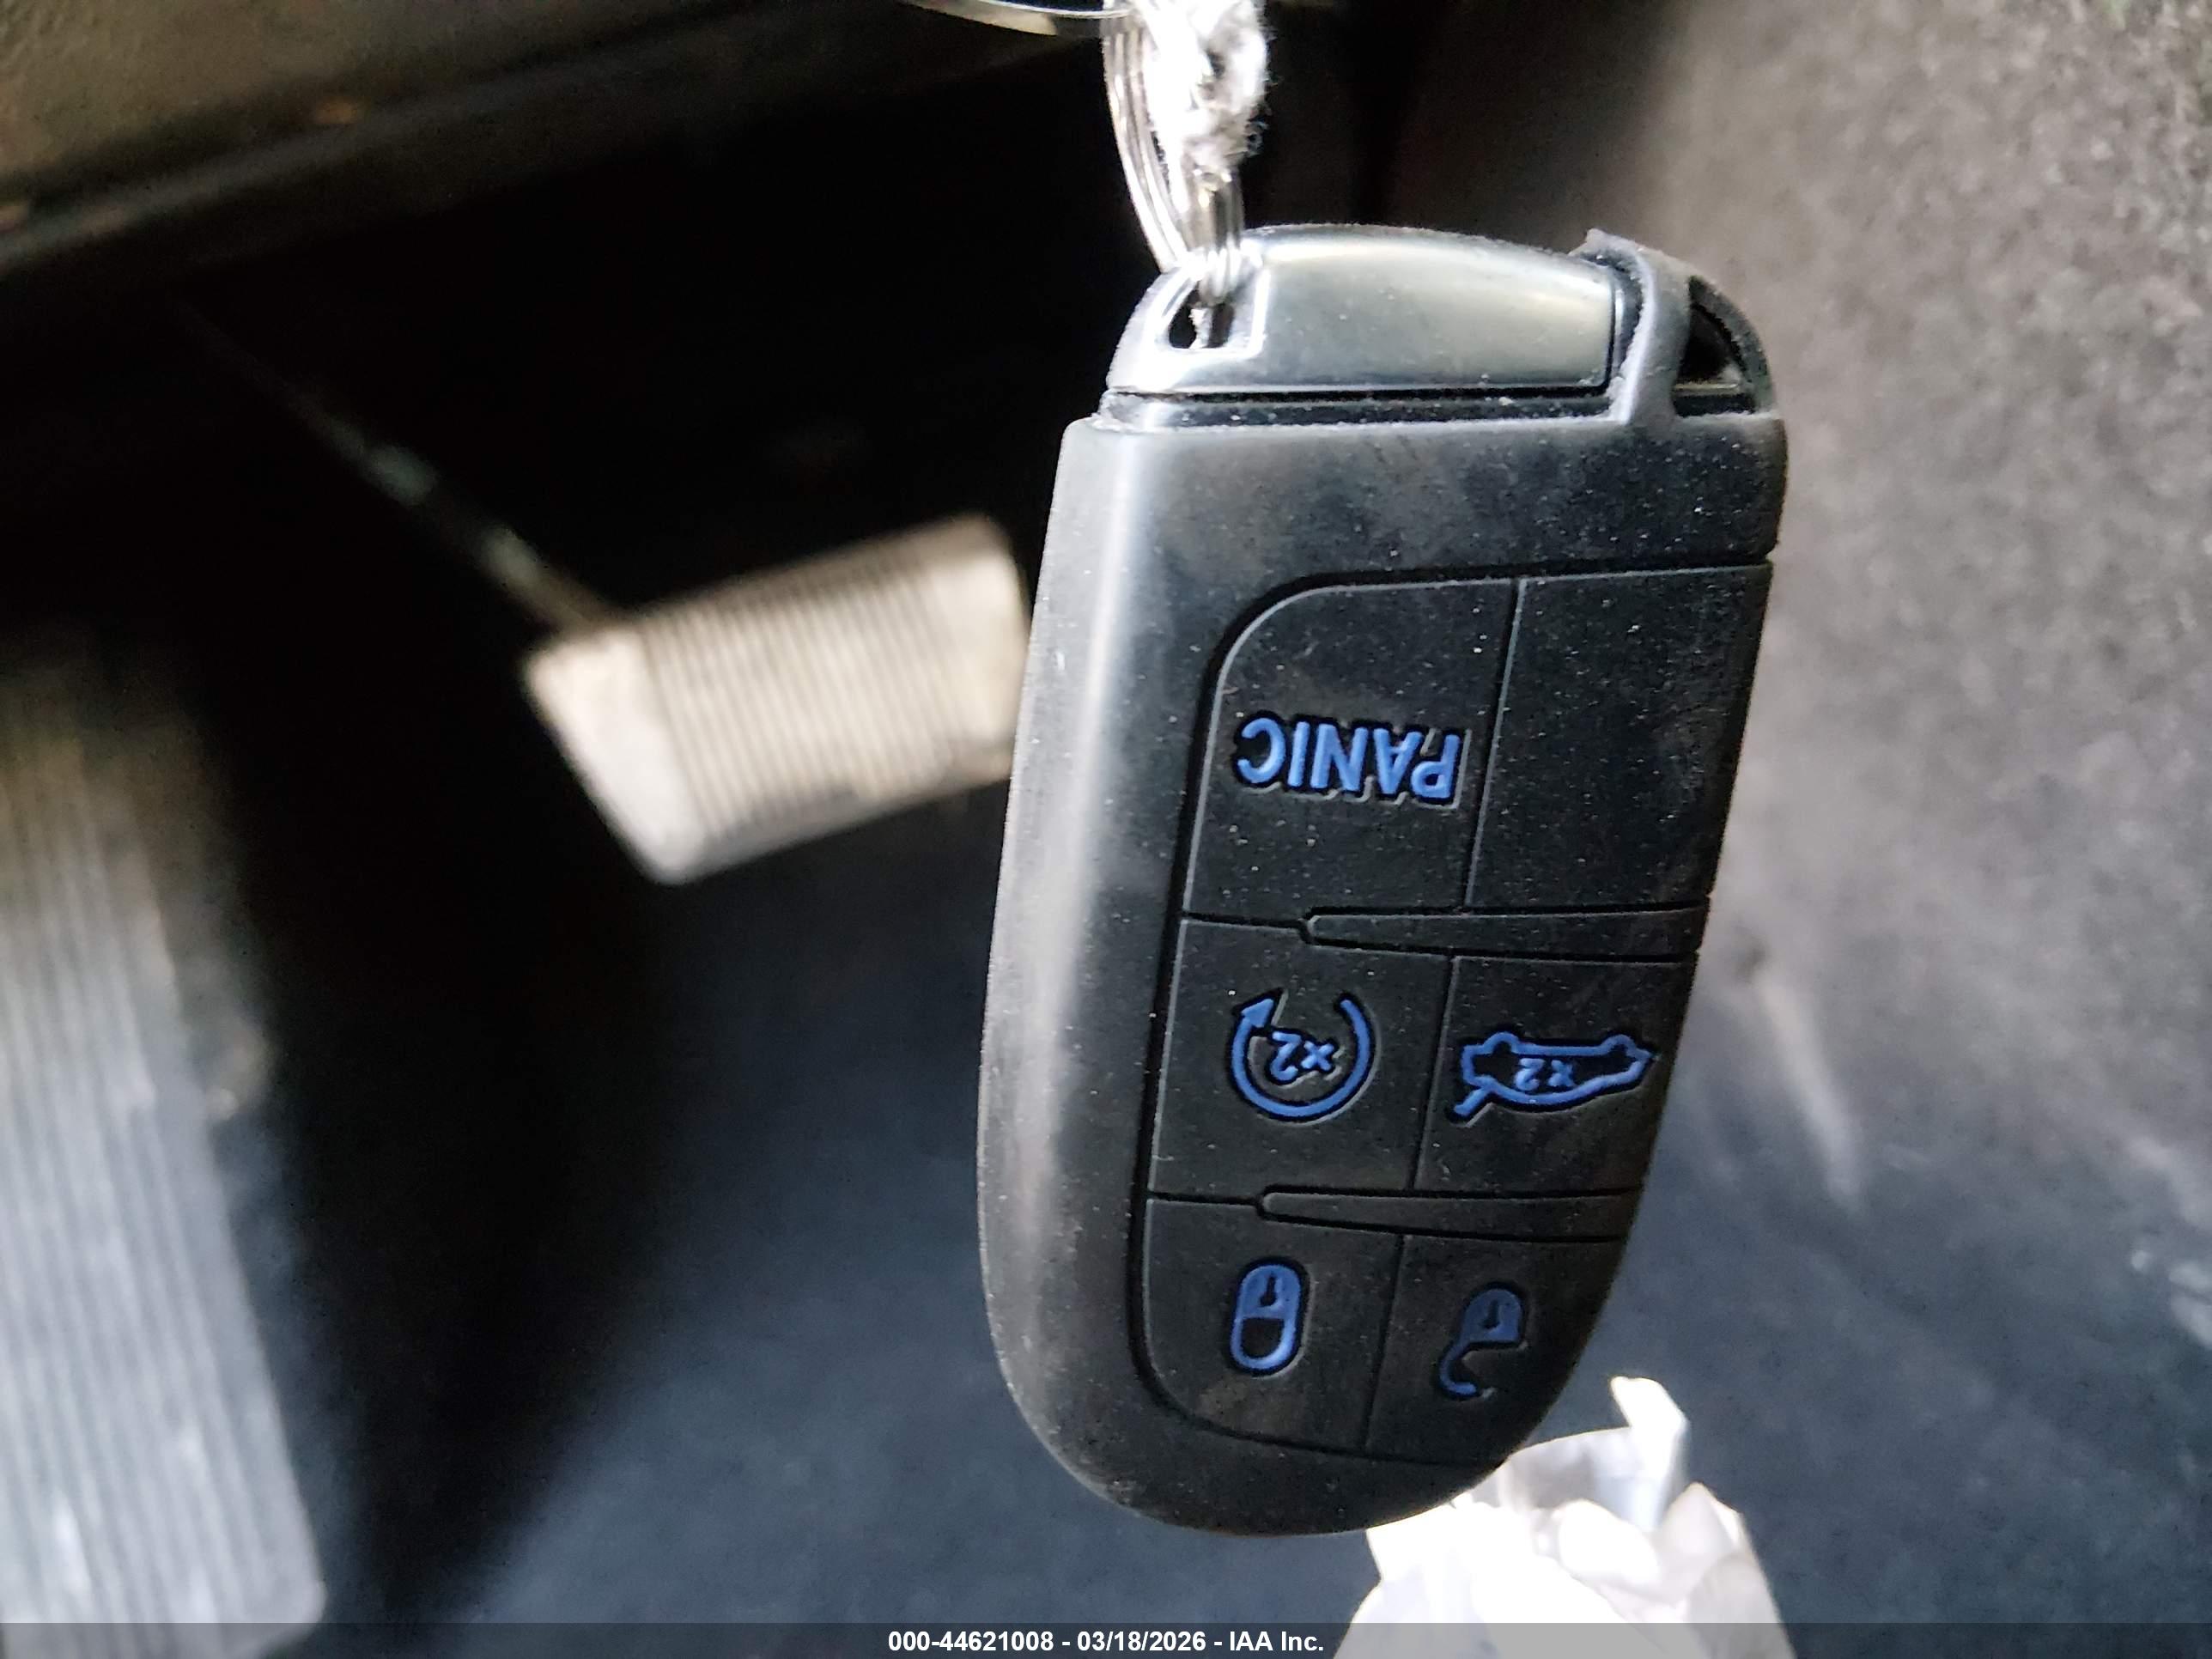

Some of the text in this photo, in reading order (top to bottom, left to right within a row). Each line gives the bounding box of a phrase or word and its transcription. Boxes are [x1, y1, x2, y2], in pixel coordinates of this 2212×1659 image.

[1237, 718, 1460, 799] PANIC
[1269, 1031, 1336, 1082] x2
[1515, 1057, 1577, 1091] x2
